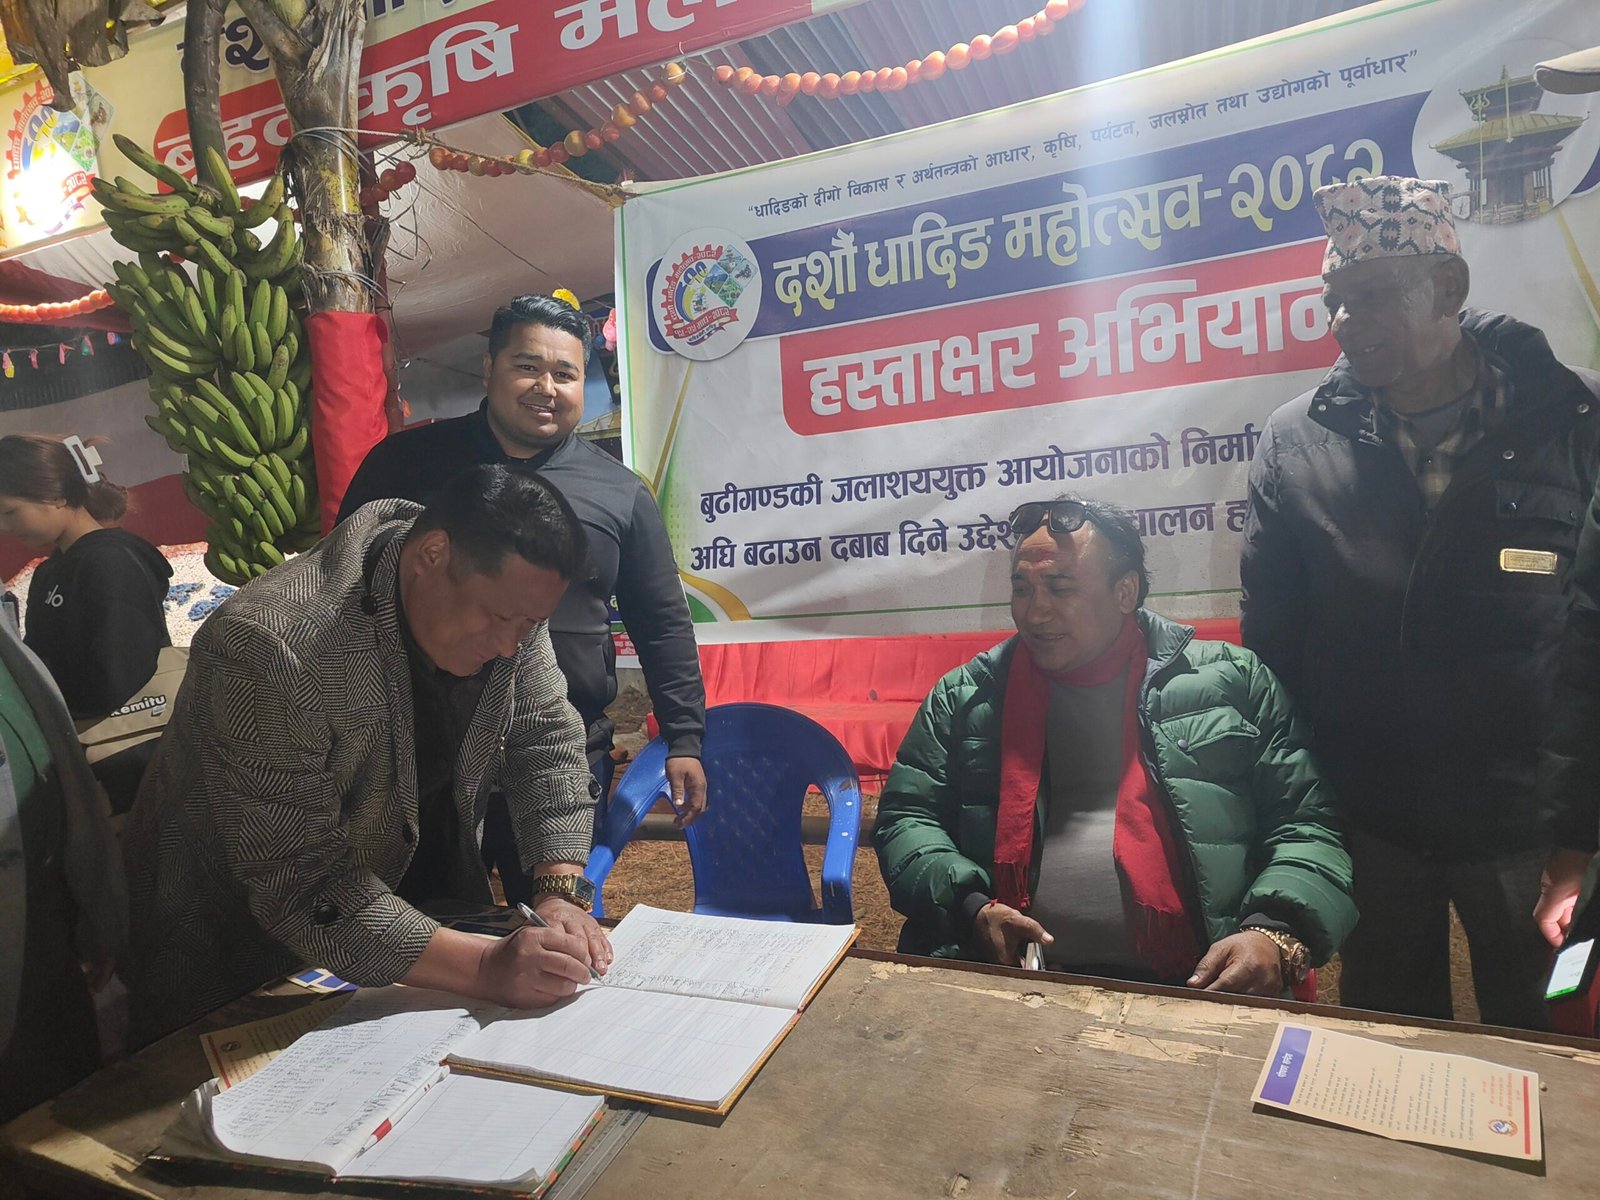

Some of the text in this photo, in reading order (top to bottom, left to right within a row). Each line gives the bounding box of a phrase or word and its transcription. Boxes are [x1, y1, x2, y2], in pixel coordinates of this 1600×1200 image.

[848, 177, 889, 197] विकास
[895, 172, 907, 190] र
[912, 154, 978, 184] अर्थतन्त्रको
[985, 145, 1035, 169] आधार,
[1089, 120, 1140, 143] पर्यटन,
[1149, 102, 1208, 129] जलस्रोत
[1216, 92, 1249, 114] तथा
[1257, 70, 1331, 104] उद्योगको
[773, 227, 858, 317] दशौं
[863, 211, 994, 290] धादिङ
[803, 322, 1040, 417] हस्ताक्षर
[700, 422, 1263, 523] बुढीगण्डकी जलाशययुक्त आयोजनाको निर्मा
[691, 535, 737, 572] अघि
[744, 536, 822, 568] बढाउन
[829, 530, 891, 562] दबाब
[899, 518, 950, 557] दिने
